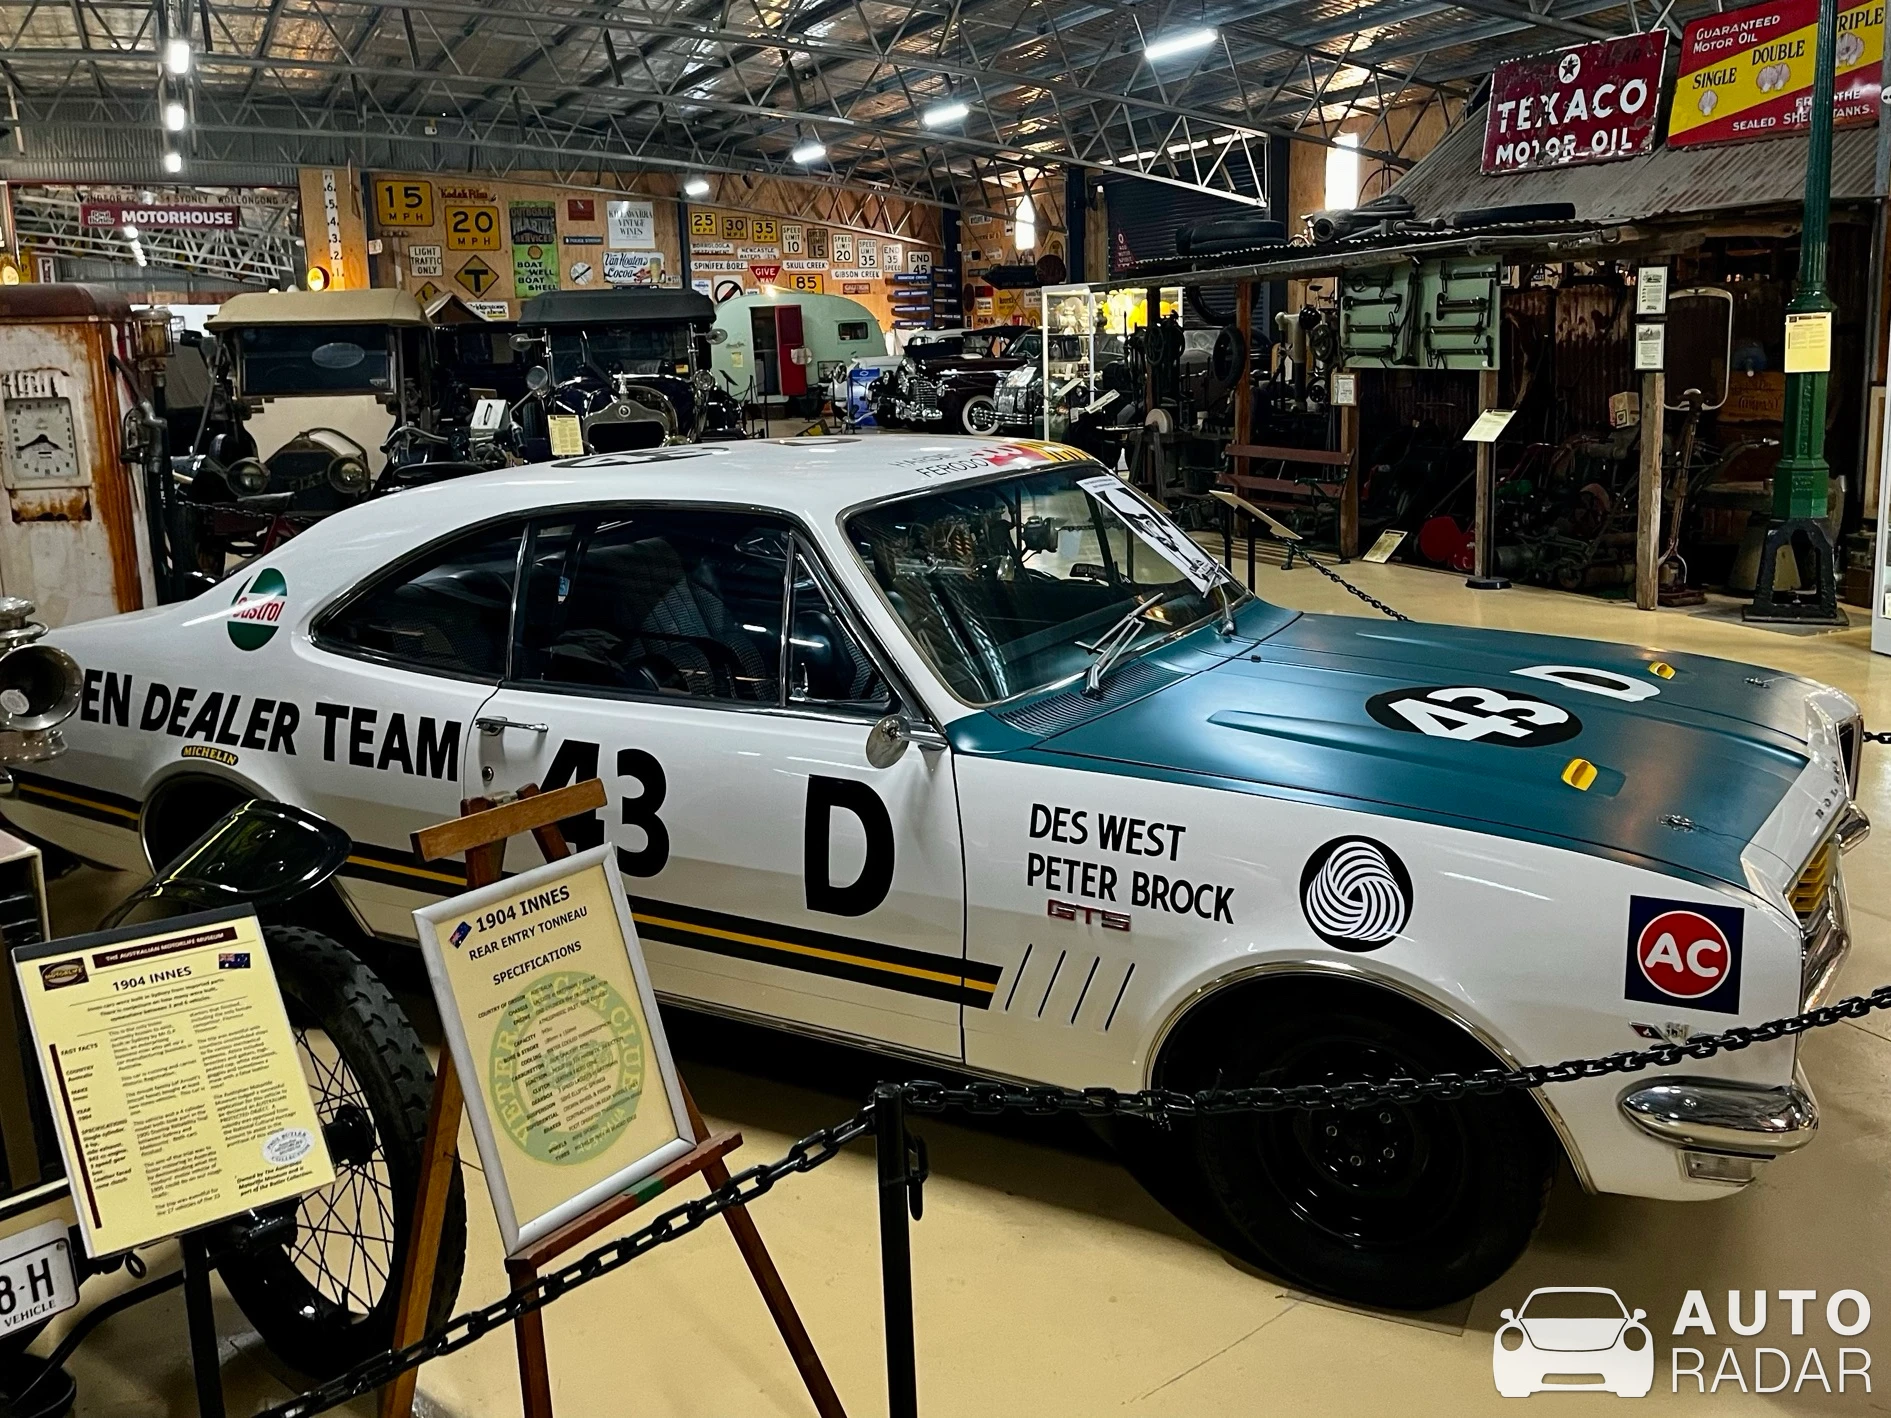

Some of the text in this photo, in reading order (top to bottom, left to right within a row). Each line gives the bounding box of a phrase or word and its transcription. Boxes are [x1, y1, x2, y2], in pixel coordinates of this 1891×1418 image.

[1697, 15, 1782, 42] GUARANTEED
[1693, 31, 1760, 54] MOTOR OIL
[1752, 39, 1807, 66] DOUBLE
[1692, 67, 1738, 90] SINGLE
[1498, 79, 1649, 134] TEXACO
[1733, 117, 1778, 131] SEALED
[1496, 128, 1633, 165] MOTOR OIL
[327, 183, 333, 192] 6
[440, 189, 468, 199] Kodak
[329, 200, 336, 209] 5
[385, 186, 423, 209] 15
[122, 210, 234, 225] MOTORHOUSE
[330, 217, 337, 226] 4
[453, 211, 494, 233] 20
[618, 218, 645, 227] VINTAGE
[694, 215, 713, 226] 25
[726, 219, 744, 231] 30
[756, 222, 774, 234] 35
[783, 226, 801, 234] SPEED
[332, 234, 338, 243] 3
[414, 248, 437, 256] LIGHT
[787, 241, 800, 253] 10
[813, 245, 825, 257] 15
[884, 246, 901, 254] END
[334, 251, 340, 260] 2
[411, 257, 442, 265] TRAFFIC
[604, 253, 620, 266] Van
[836, 250, 851, 262] 20
[861, 255, 876, 266] 35
[888, 255, 900, 264] 35
[911, 254, 930, 263] END
[417, 267, 438, 275] ONLY
[694, 262, 745, 271] SPINIFEX BORE
[755, 267, 776, 276] GIVE
[786, 261, 805, 269] SKULL
[913, 264, 928, 275] 45
[607, 268, 634, 278] Cocoa
[835, 270, 859, 278] GIBSON
[796, 276, 817, 290] 85
[916, 458, 989, 477] FERODO
[1509, 665, 1660, 702] D
[1388, 687, 1570, 741] 43
[139, 682, 301, 757] DEALER
[314, 701, 462, 784] TEAM
[183, 746, 237, 765] MICHELIN
[1029, 803, 1187, 861] DES WEST
[803, 773, 895, 919] D
[1027, 852, 1236, 925] PETER BROCK
[474, 884, 571, 933] 1904 INNES
[1047, 899, 1131, 932] GTS
[468, 905, 589, 961] REAR ENTRY TONNEAU
[118, 945, 160, 959] AUSTRALIAN
[160, 938, 195, 950] MOTORLIFE
[195, 932, 224, 943] MUSEUM
[1645, 932, 1722, 978] AC
[491, 940, 583, 985] SPECIFICATIONS
[111, 965, 192, 992] 1904 INNES
[477, 1001, 507, 1019] COUNTRY OF
[512, 1032, 536, 1048] CAPACITY
[60, 1042, 98, 1056] FAST FACTS
[520, 1042, 539, 1055] STROKE
[520, 1052, 542, 1067] COOLING
[70, 1086, 88, 1095] MAKE
[532, 1081, 551, 1095] CLUTCH
[530, 1090, 553, 1107] GEARBOX
[75, 1107, 91, 1115] YEAR
[4, 1300, 57, 1327] VEHICLE
